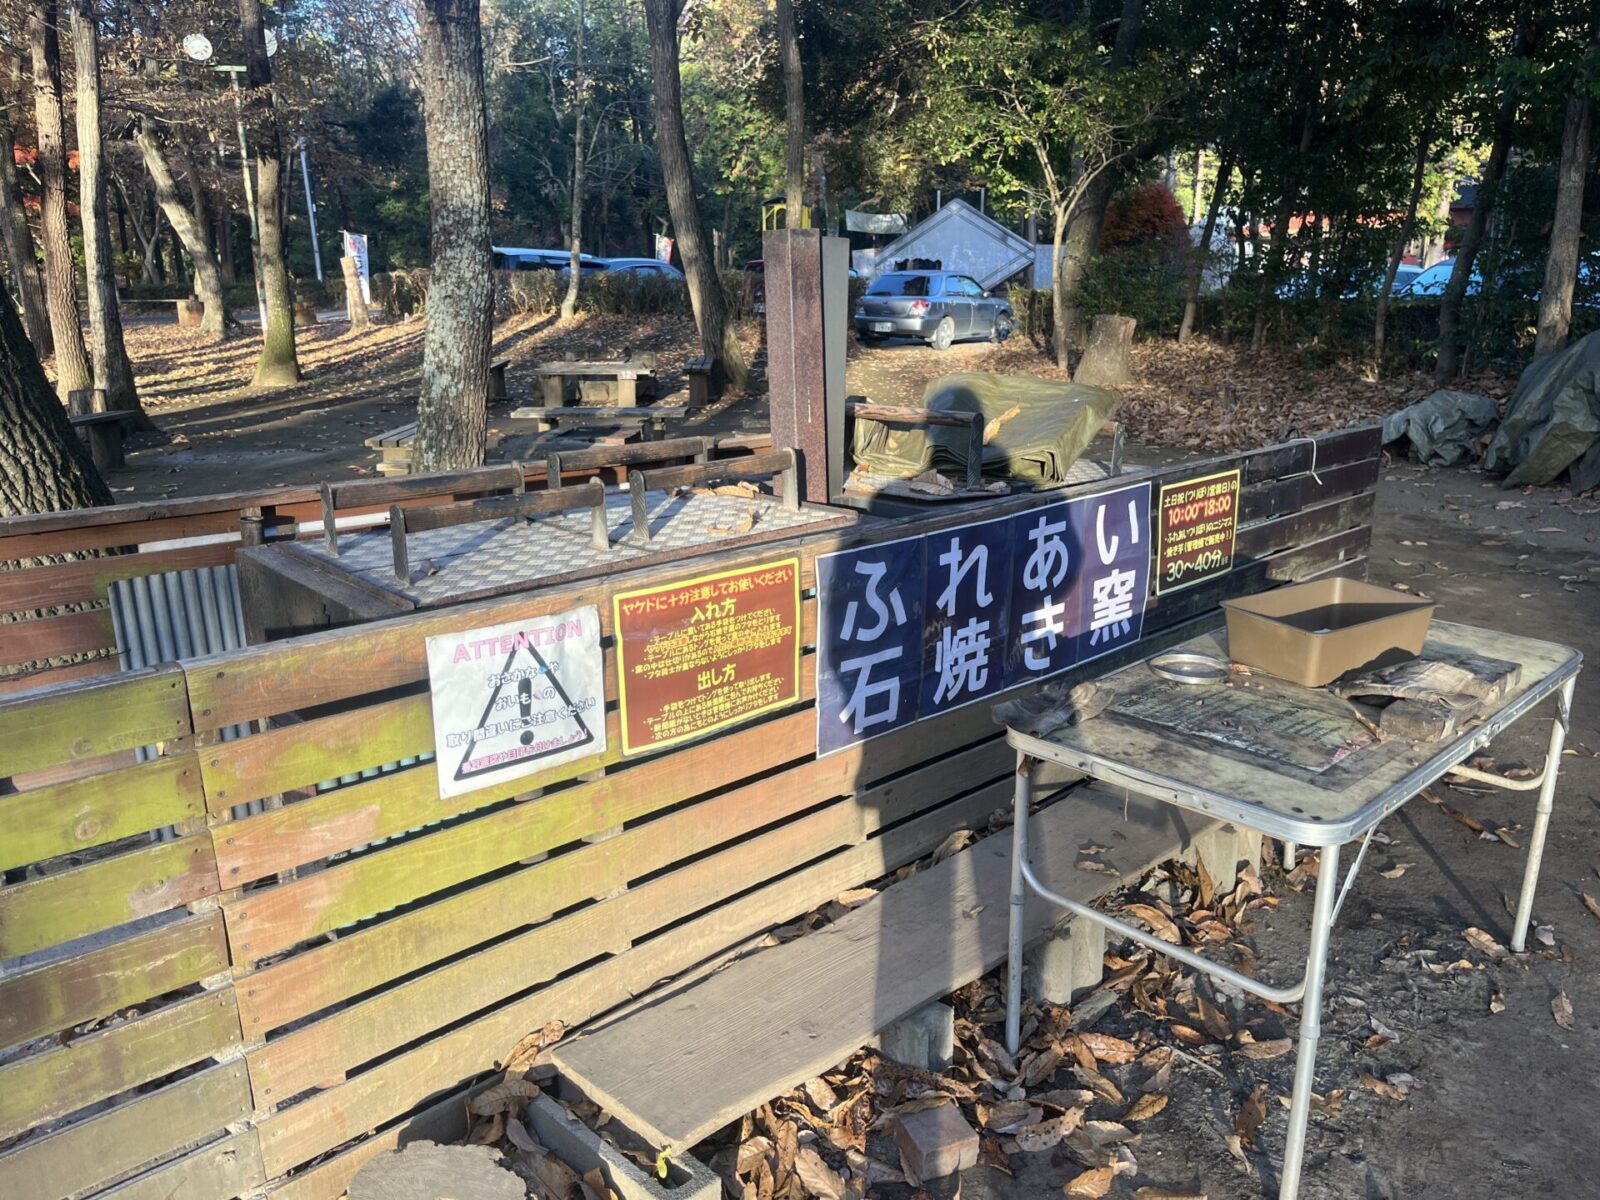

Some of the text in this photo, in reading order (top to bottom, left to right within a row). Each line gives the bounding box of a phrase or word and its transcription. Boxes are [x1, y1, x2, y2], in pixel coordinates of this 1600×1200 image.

[622, 569, 793, 615] ヤケドに十分注意してお使いください
[840, 500, 1139, 641] ふれあい
[690, 598, 737, 624] 入れ方
[453, 619, 583, 663] ATTENTION
[839, 568, 1137, 734] 石焼き窯
[697, 663, 737, 691] 出し方
[446, 697, 597, 748] 取り間違いにご注意ください
